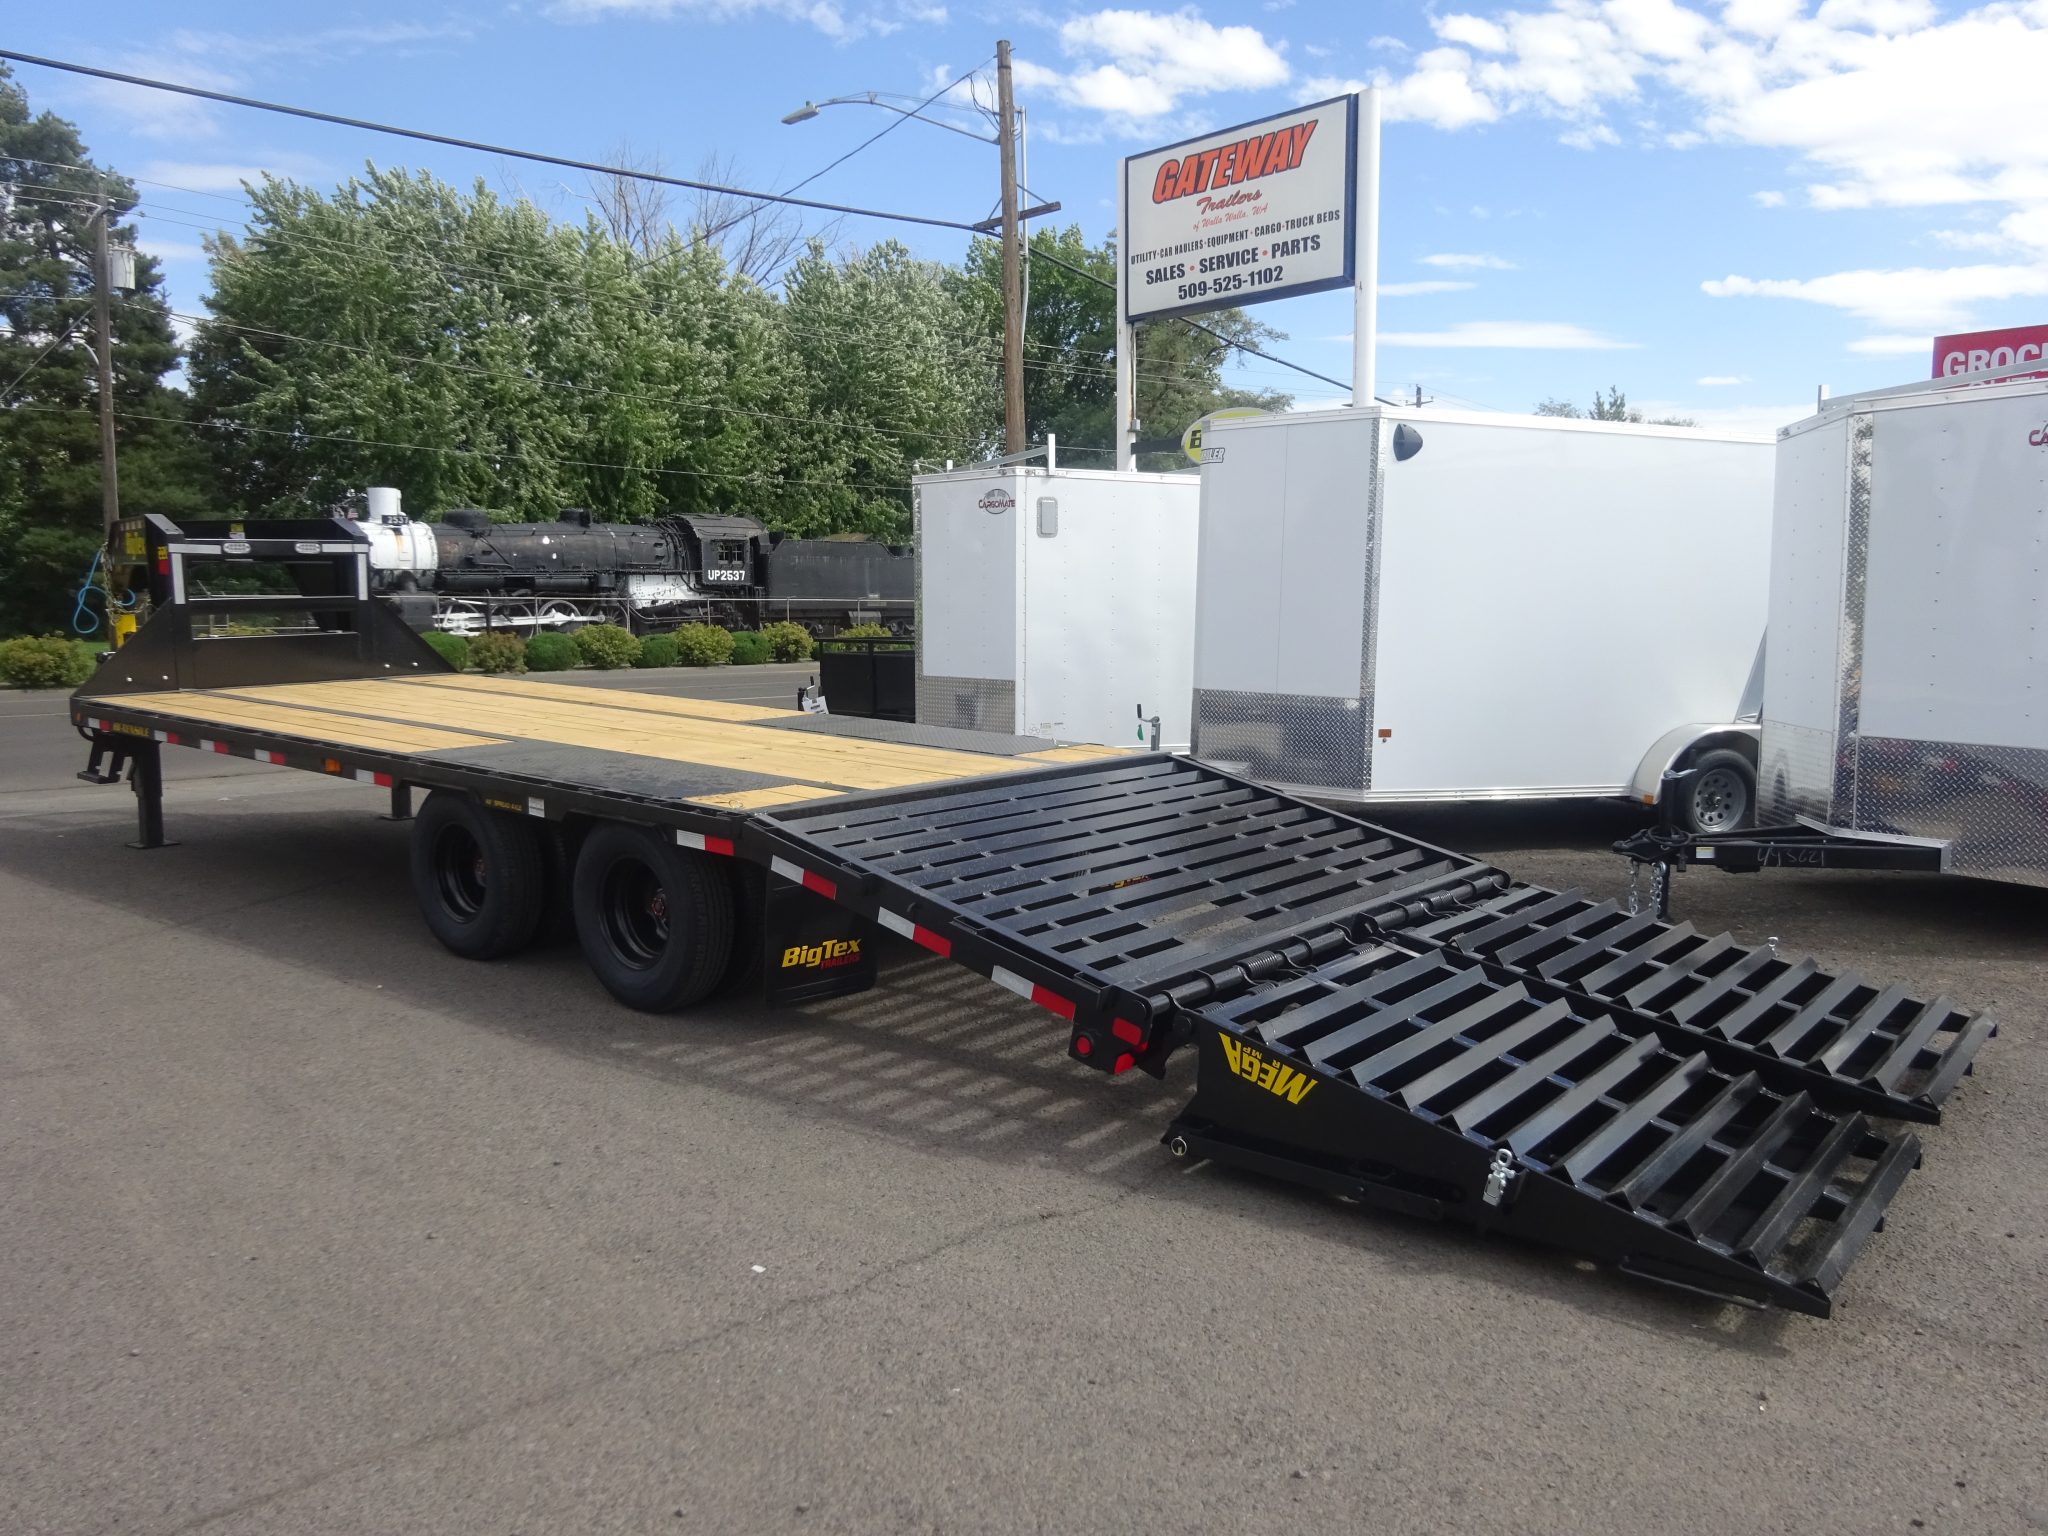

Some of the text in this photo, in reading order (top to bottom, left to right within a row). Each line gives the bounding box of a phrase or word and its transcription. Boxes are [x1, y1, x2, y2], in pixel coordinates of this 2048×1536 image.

[1152, 119, 1318, 204] GATEWAY
[1193, 221, 1200, 232] of
[1202, 215, 1223, 228] Walla
[1252, 203, 1268, 215] WA
[1196, 189, 1262, 215] Trailers
[1174, 240, 1203, 255] HAULERS
[1207, 229, 1248, 248] EQUIPMENT
[1254, 222, 1281, 237] CARGO
[1285, 215, 1314, 231] TRUCK
[1316, 209, 1340, 224] BEDS
[1146, 234, 1320, 285] SALES SERVICE PARTS
[1178, 265, 1283, 300] 509-525-1102
[1942, 342, 2048, 378] GROC
[707, 569, 745, 581] UP2537
[781, 939, 861, 967] BigTex
[1218, 1031, 1318, 1105] MEGA
